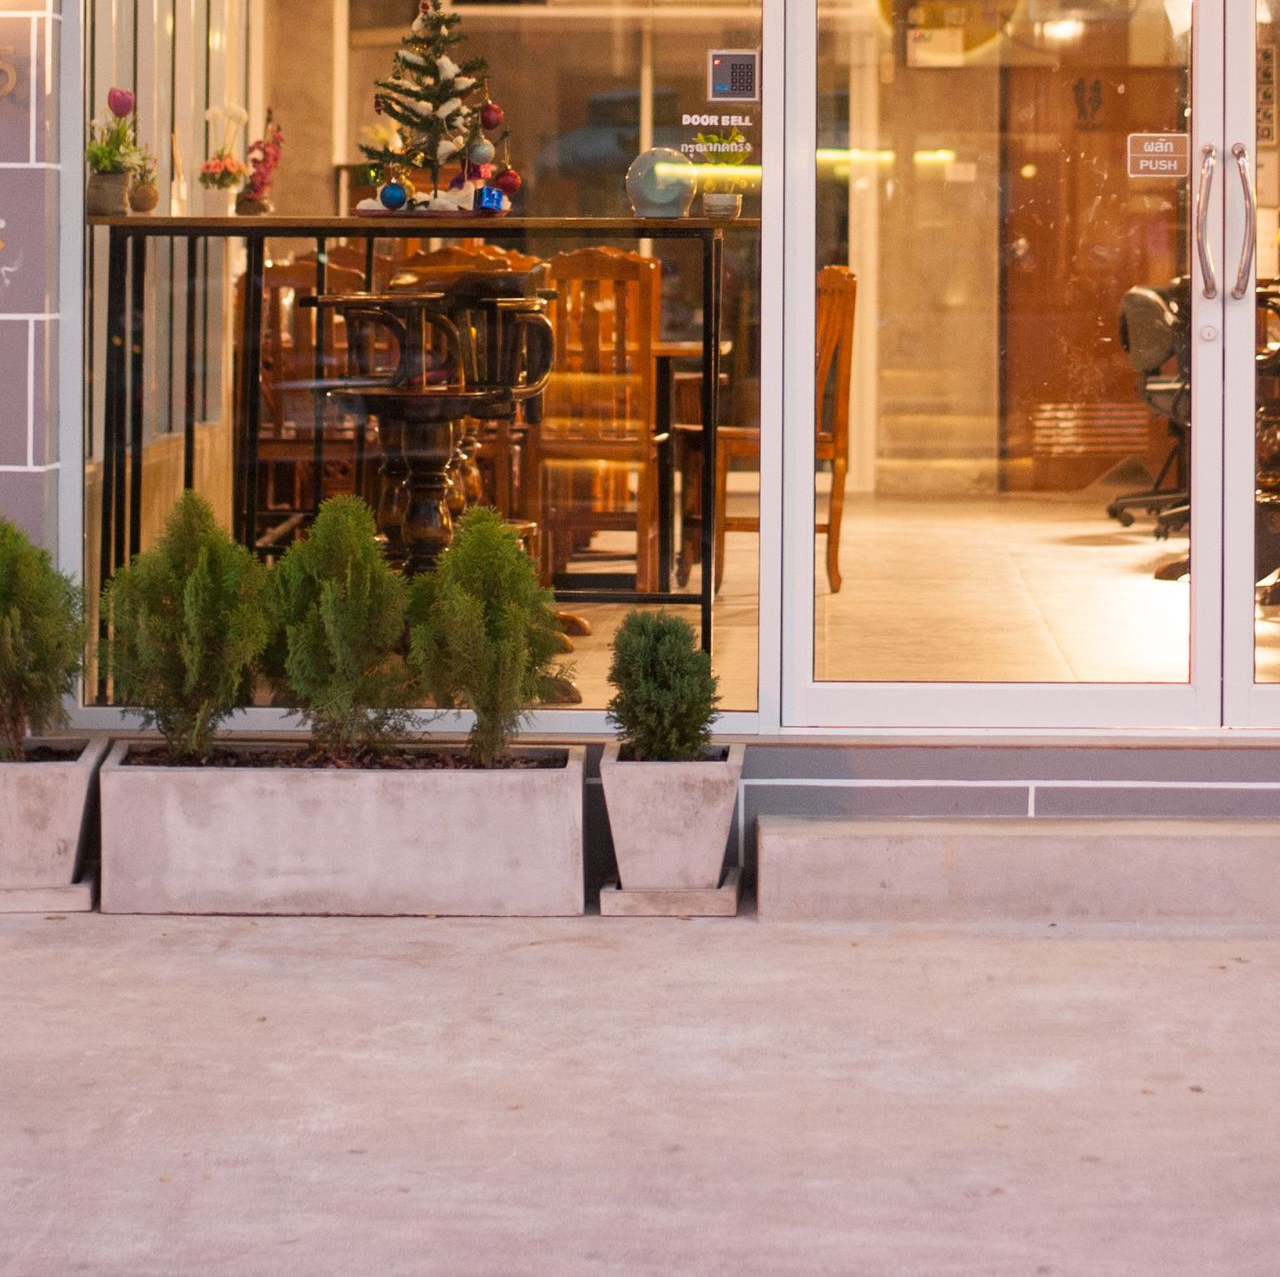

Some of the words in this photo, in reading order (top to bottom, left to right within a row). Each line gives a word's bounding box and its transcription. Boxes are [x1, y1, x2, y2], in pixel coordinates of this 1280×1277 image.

[682, 114, 719, 126] DOOR
[721, 115, 753, 126] BELL
[1140, 159, 1177, 171] PUSH
